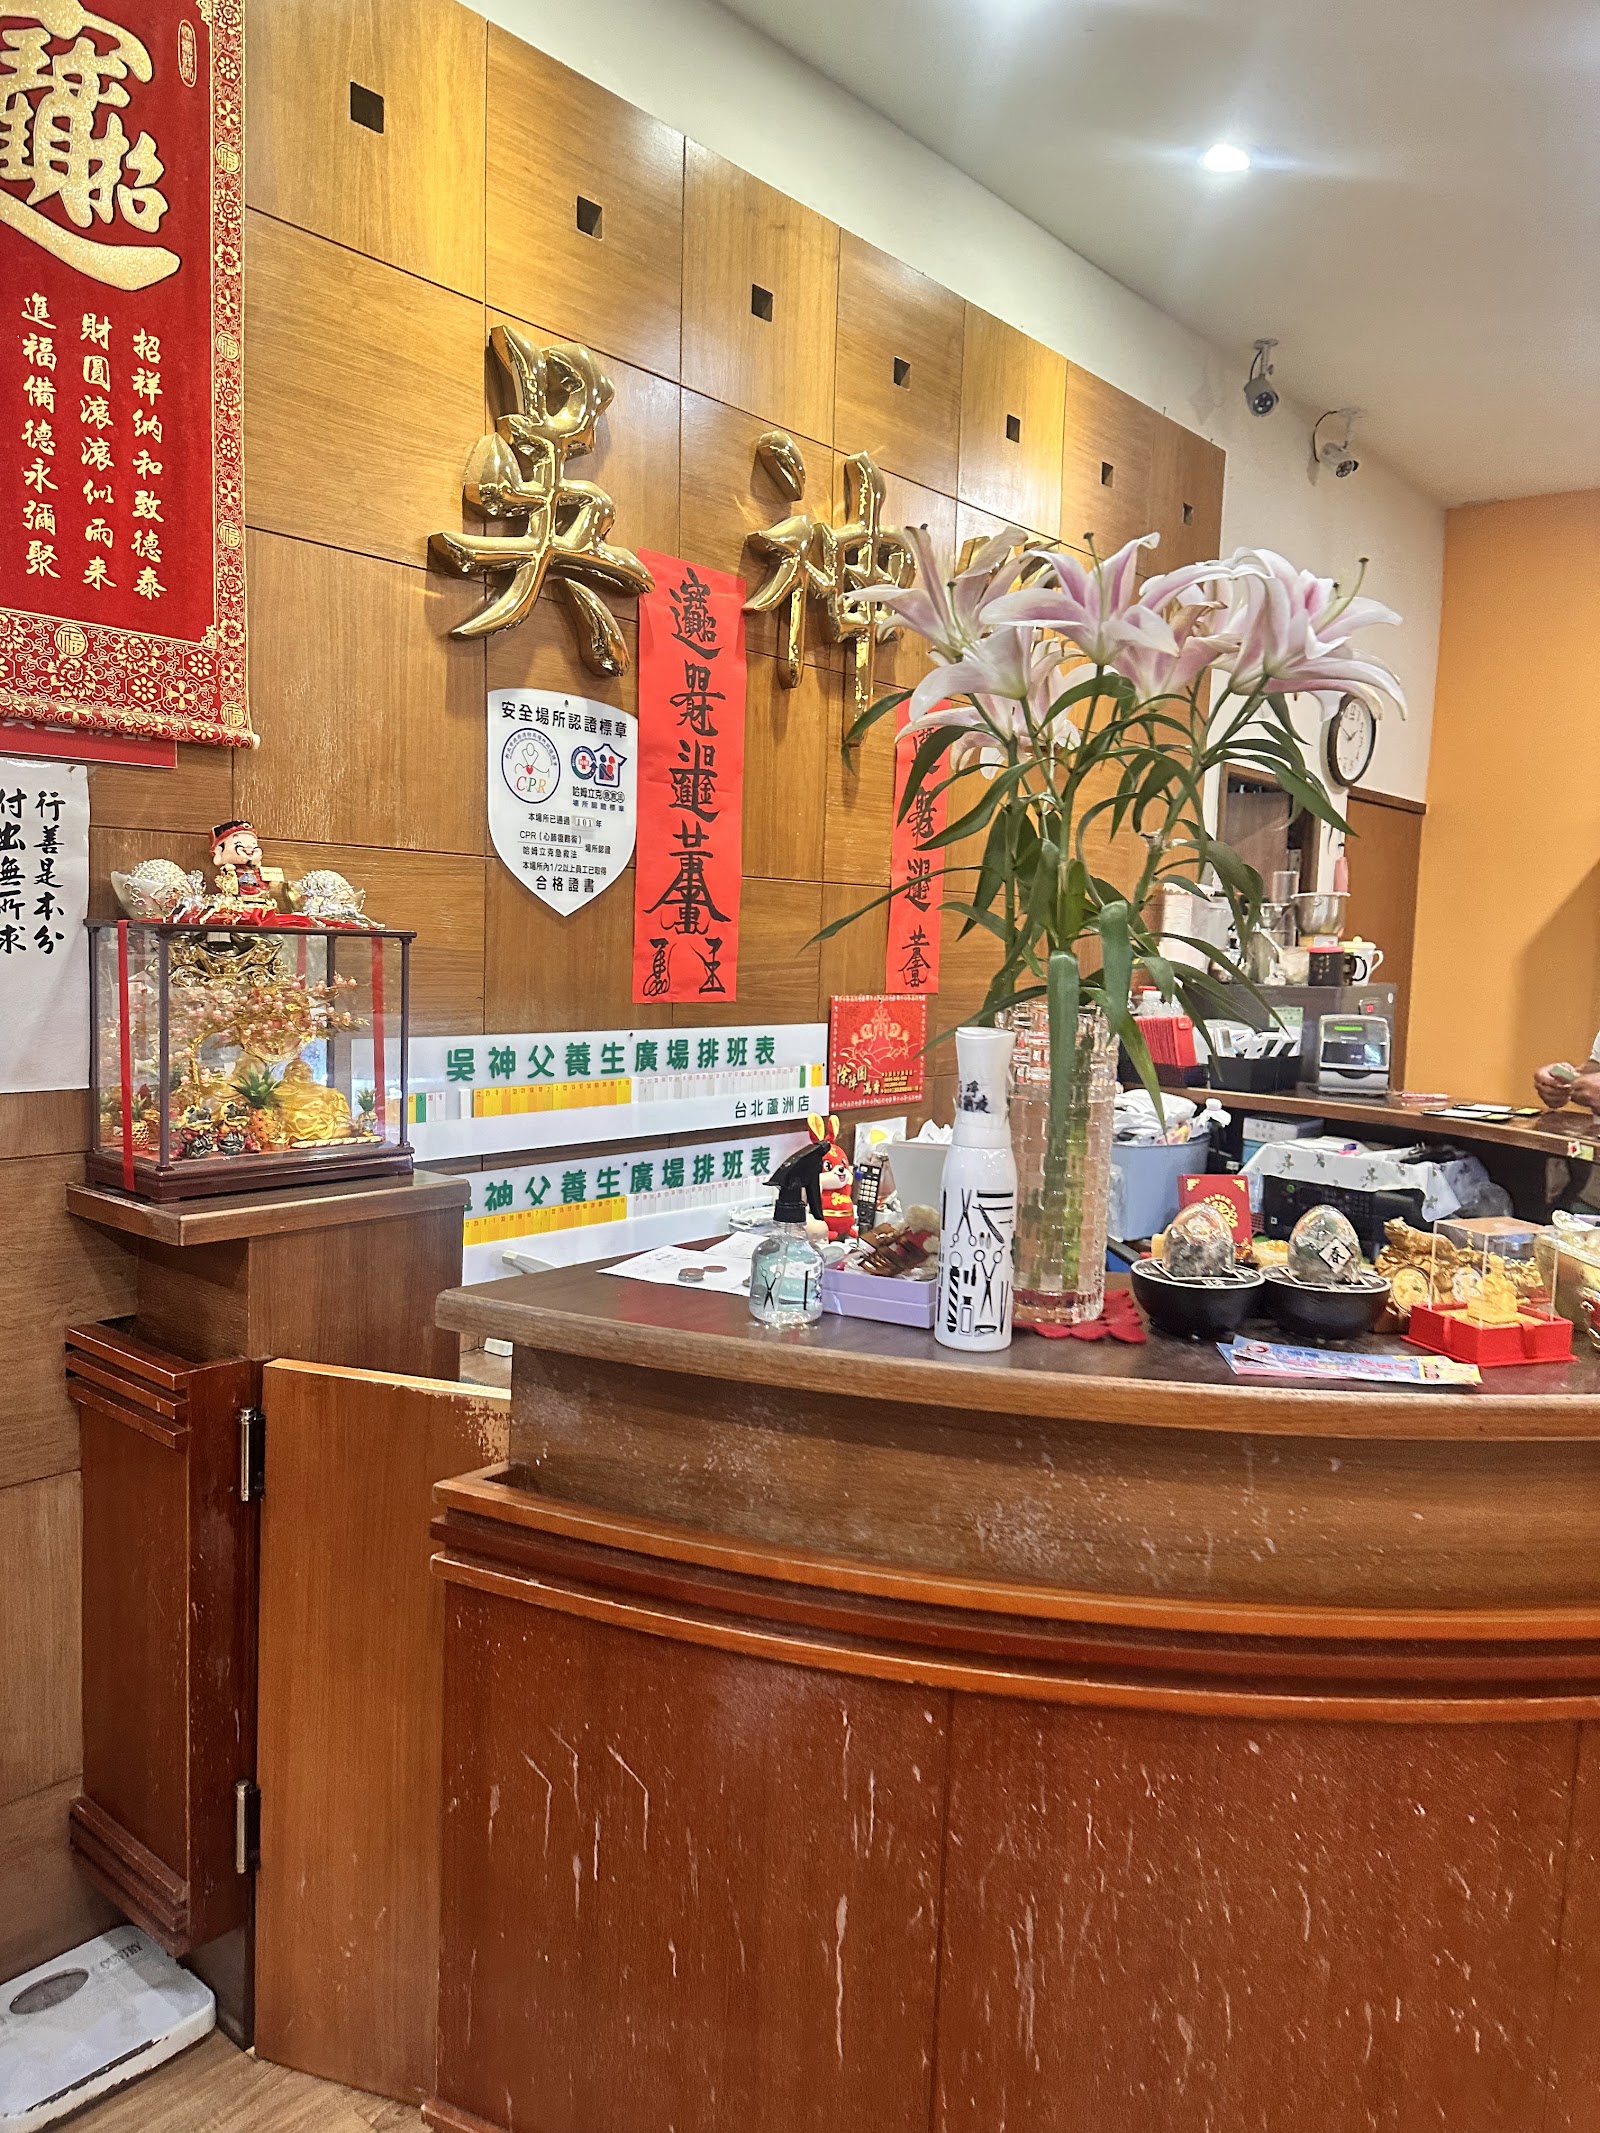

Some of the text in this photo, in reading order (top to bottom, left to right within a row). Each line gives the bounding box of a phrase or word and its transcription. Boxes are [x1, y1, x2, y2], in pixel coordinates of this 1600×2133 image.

[501, 701, 628, 738] 安全場所認證標章
[516, 776, 547, 794] CPR
[595, 819, 603, 828] 年
[33, 790, 67, 955] 行善是本分
[535, 874, 595, 894] 合格證書
[446, 1035, 776, 1083] 吳神父養生廣場排班表
[734, 1095, 810, 1119] 台北蘆洲店
[464, 1146, 771, 1212] 神父養生廣場排班表
